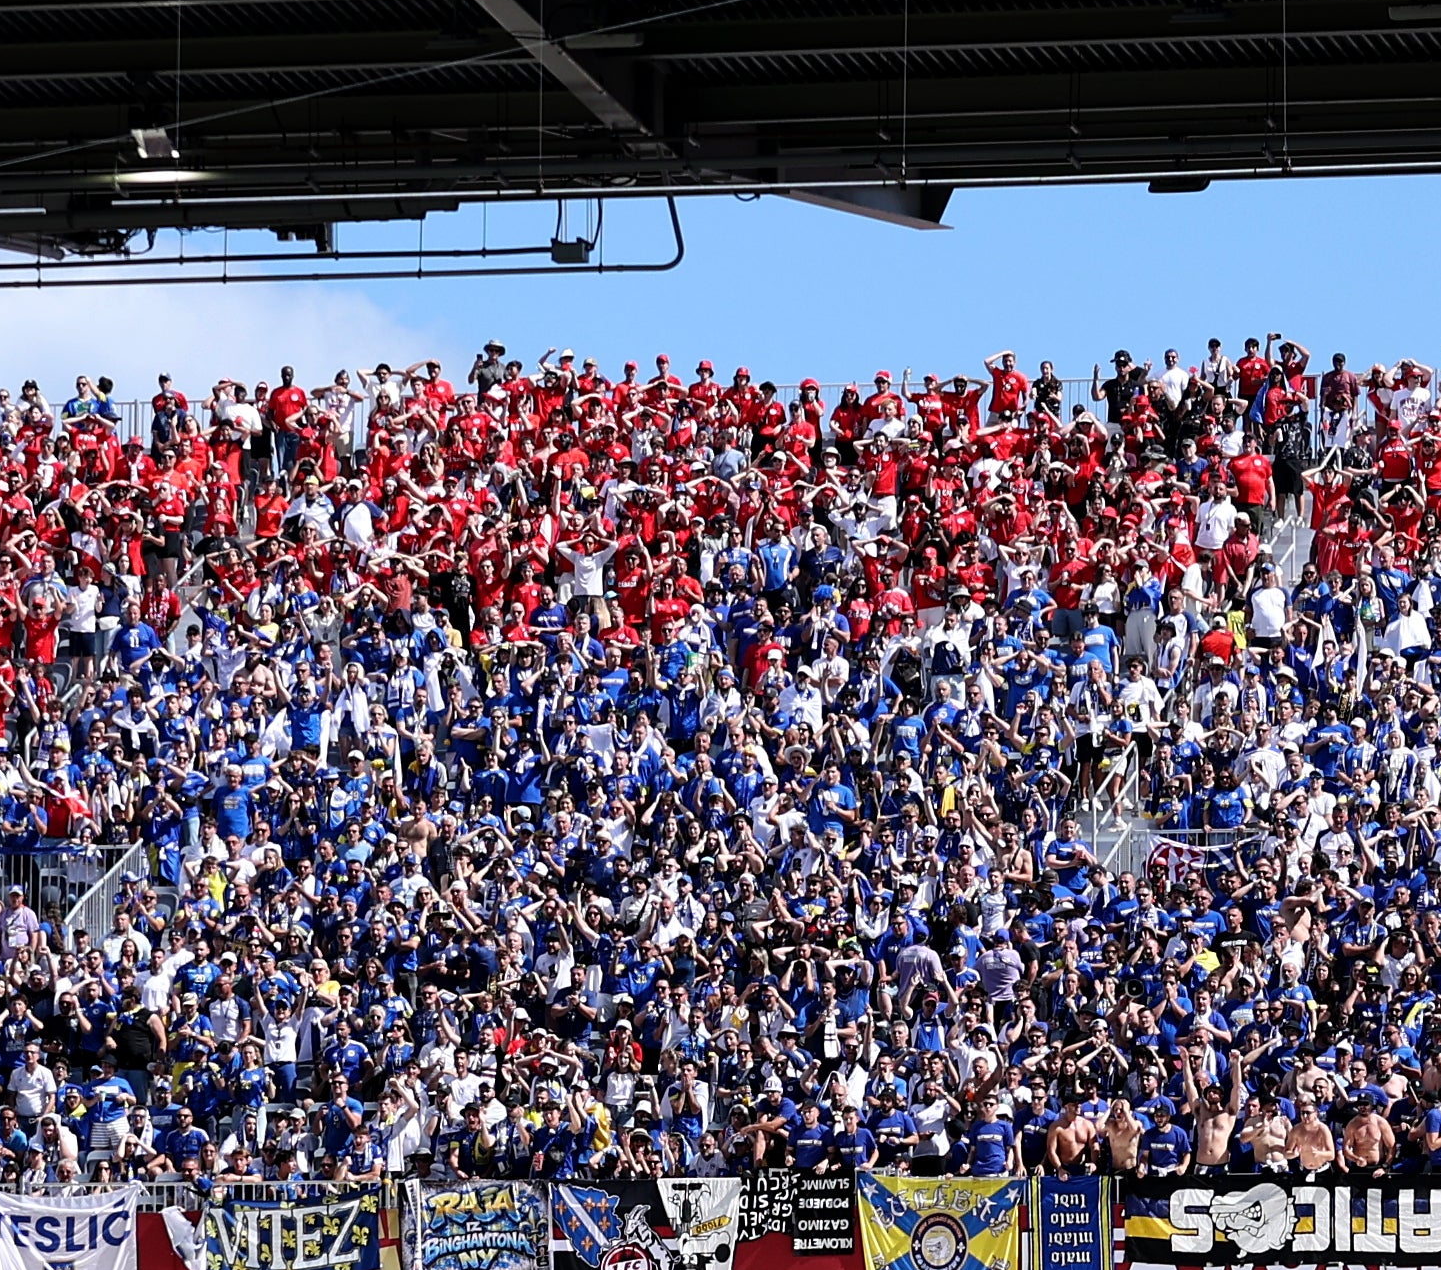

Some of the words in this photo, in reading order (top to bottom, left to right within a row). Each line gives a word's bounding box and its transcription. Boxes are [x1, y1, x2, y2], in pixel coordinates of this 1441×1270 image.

[799, 1198, 849, 1209] POBJEDE
[695, 1217, 723, 1234] 71000
[798, 1219, 849, 1231] GAZIMO
[1051, 1213, 1090, 1228] malo
[210, 1200, 360, 1270] VITEZ
[794, 1238, 852, 1249] KILOMETRE
[1051, 1251, 1091, 1266] malo
